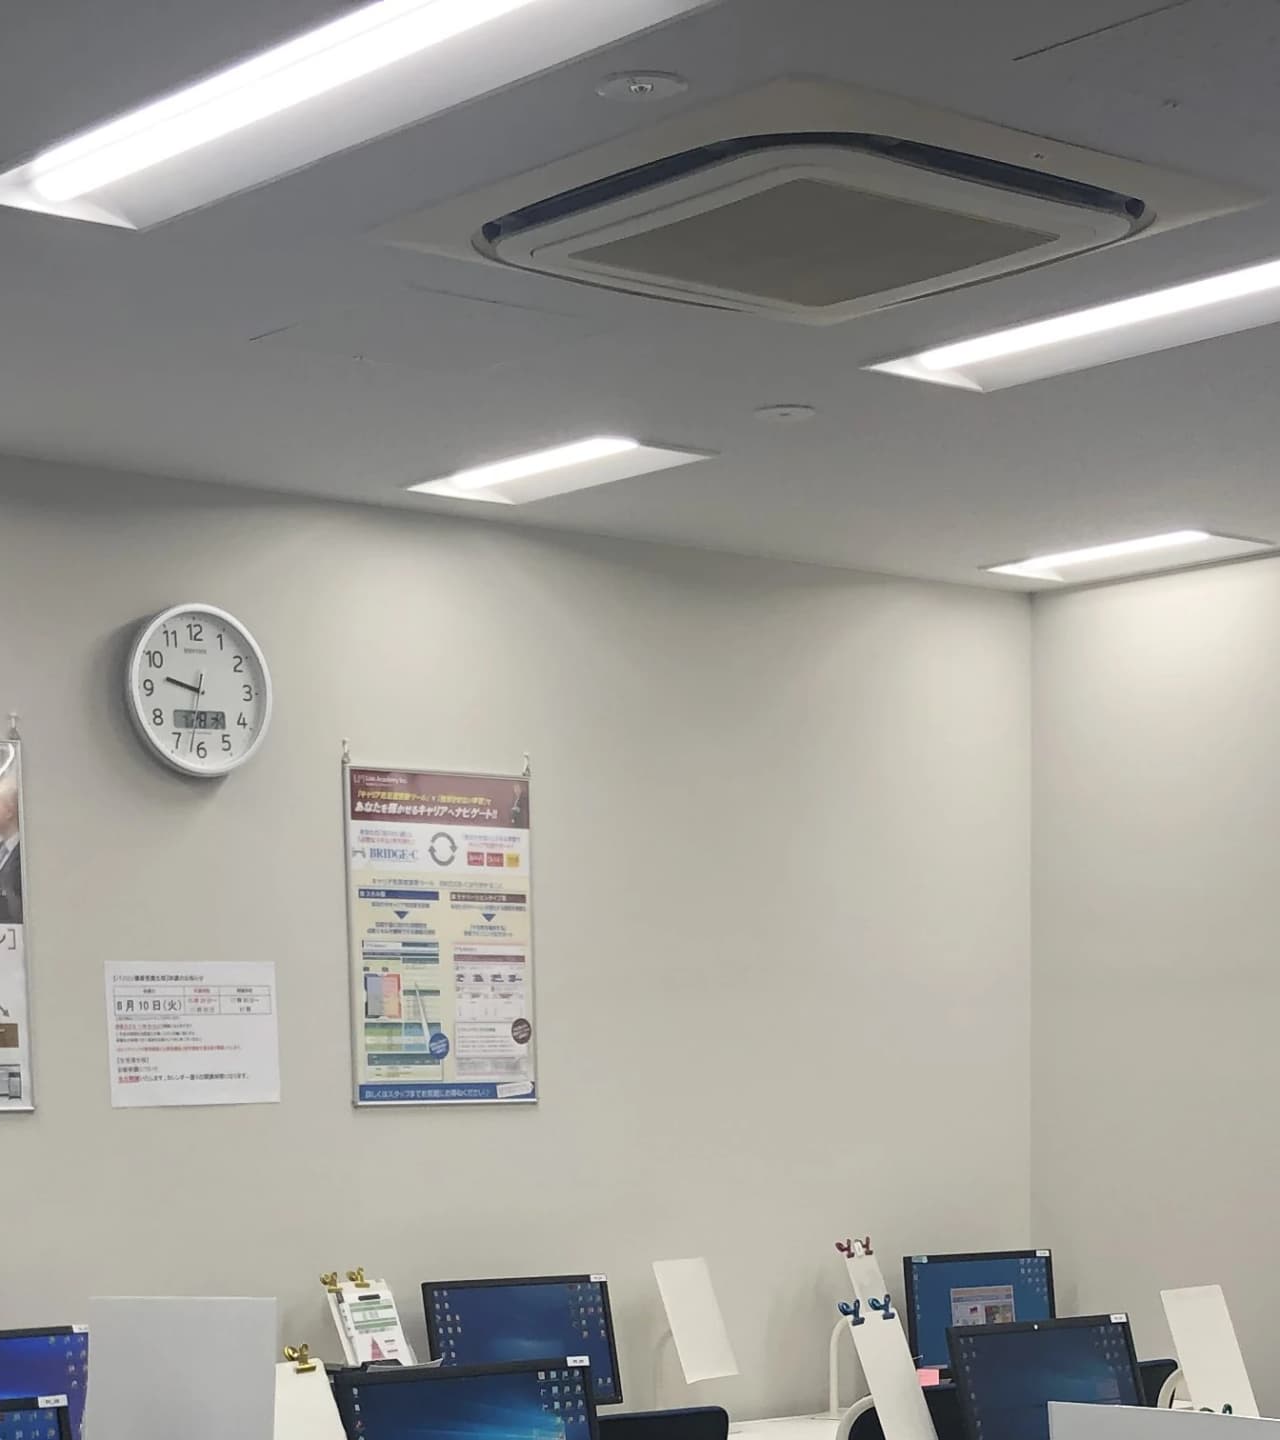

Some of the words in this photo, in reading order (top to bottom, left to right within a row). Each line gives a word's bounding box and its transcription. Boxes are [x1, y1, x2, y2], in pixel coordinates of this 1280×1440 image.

[163, 630, 178, 648] 11
[186, 623, 203, 641] 12
[216, 633, 224, 650] 1
[145, 650, 163, 668] 10
[232, 655, 243, 673] 2
[143, 679, 154, 696] 9
[242, 684, 253, 702] 3
[152, 708, 164, 726] 8
[236, 712, 248, 729] 4
[171, 732, 182, 749] 7
[221, 734, 232, 751] 5
[196, 741, 207, 759] 6
[370, 847, 418, 859] BRIDGE-C
